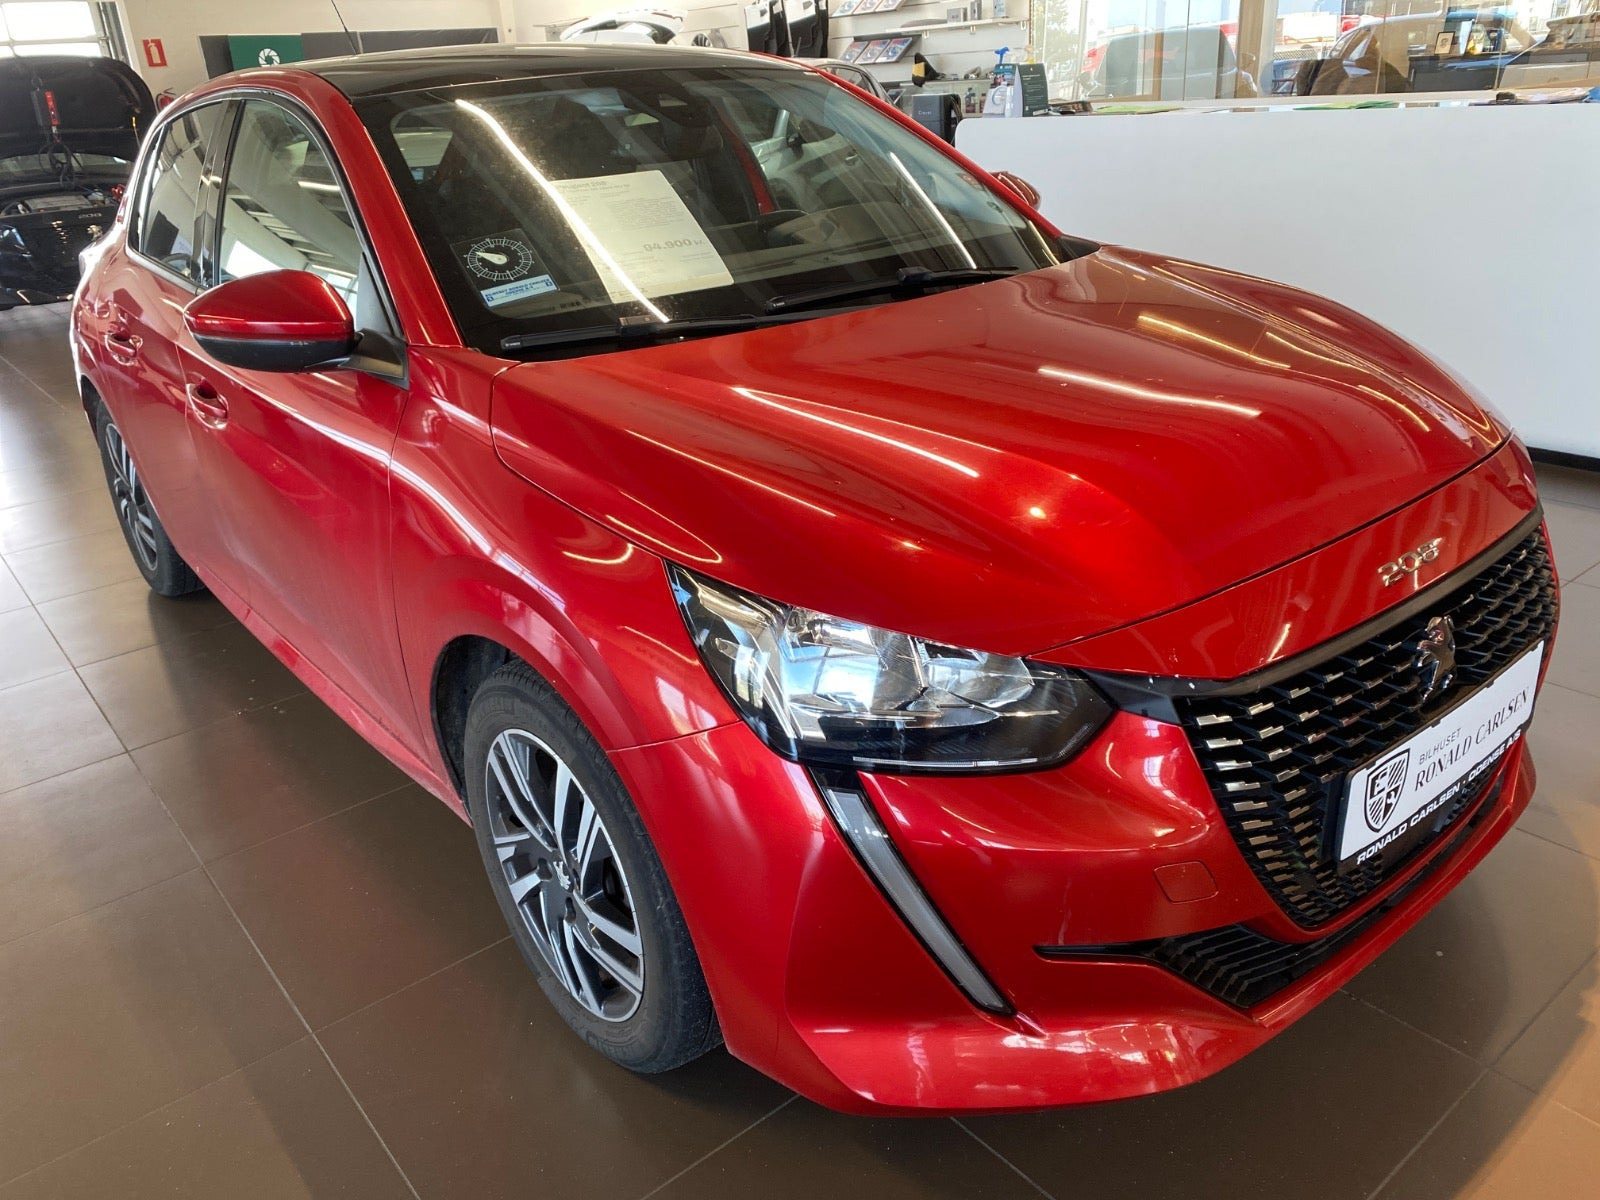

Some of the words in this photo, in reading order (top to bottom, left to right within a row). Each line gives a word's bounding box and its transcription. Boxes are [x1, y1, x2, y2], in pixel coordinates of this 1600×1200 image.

[1378, 538, 1442, 586] 208
[1414, 735, 1472, 792] RONALD
[1475, 686, 1530, 745] CARLSEN
[1418, 727, 1462, 765] BILHUSET
[1356, 822, 1408, 865] RONALD
[1409, 782, 1461, 827] CARLSEN
[1468, 743, 1506, 781] ODENSE
